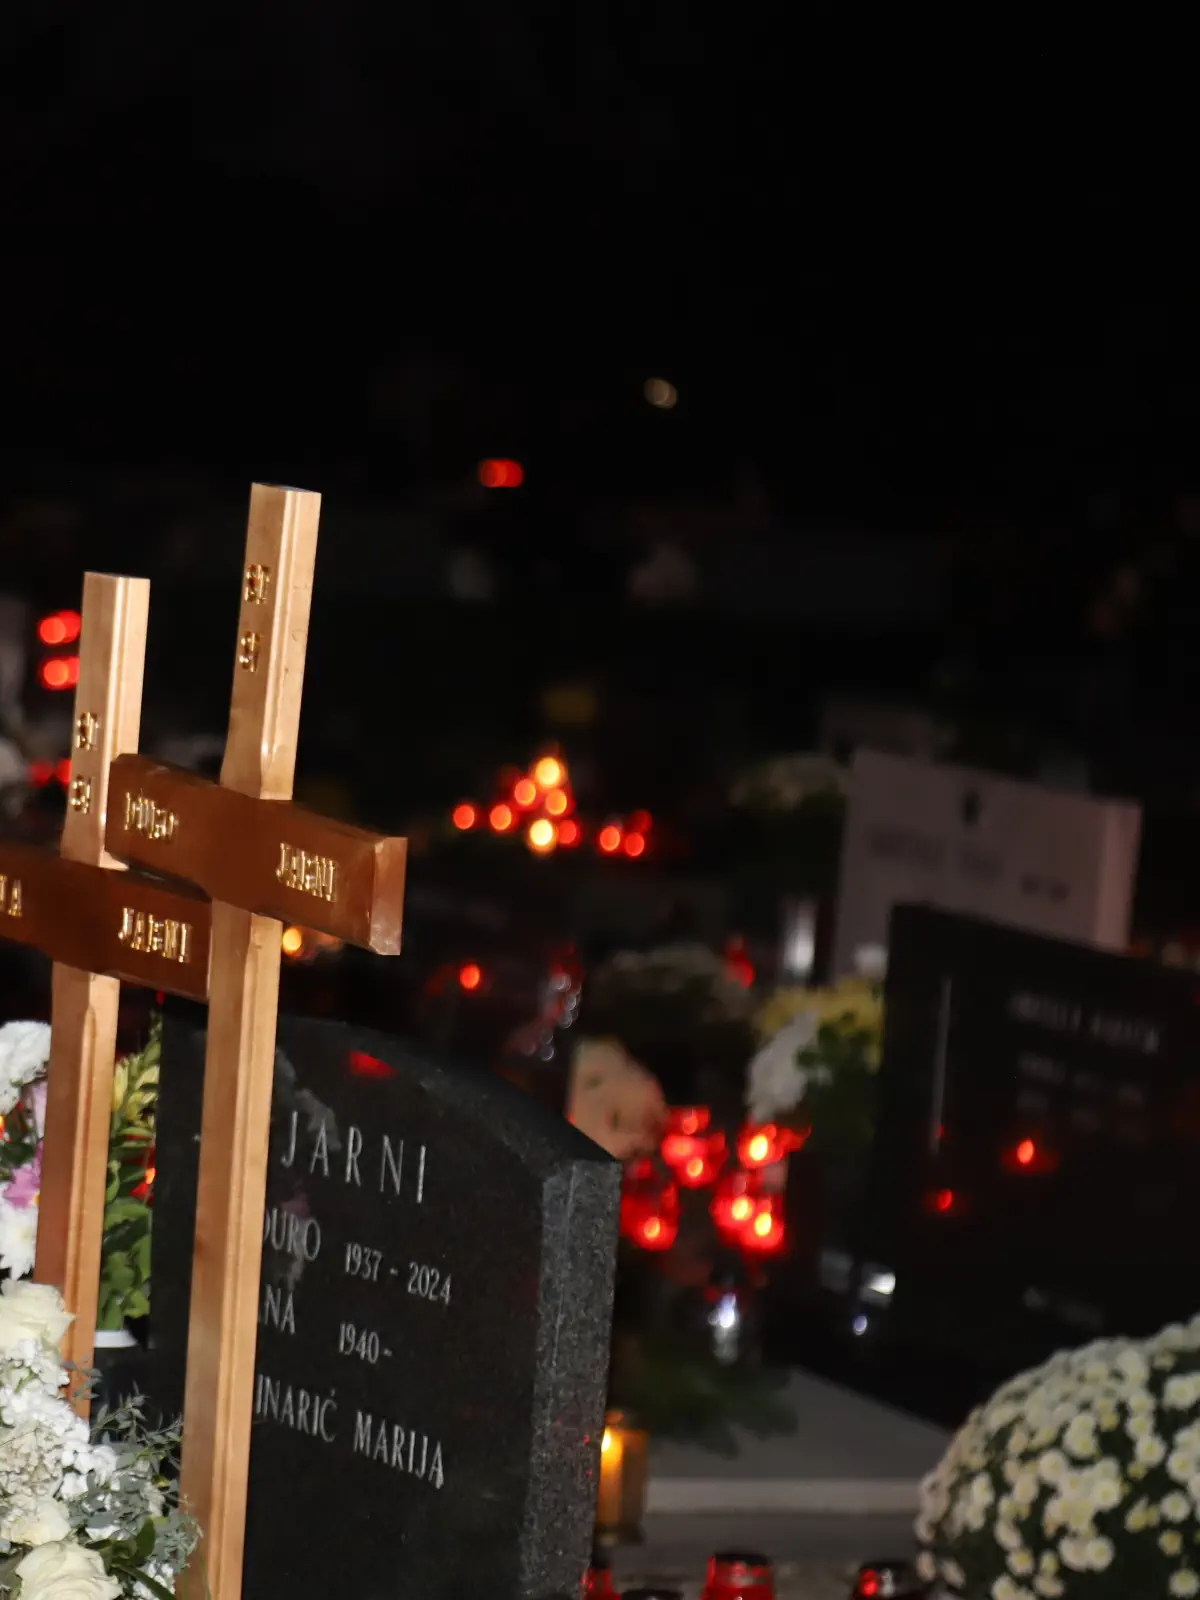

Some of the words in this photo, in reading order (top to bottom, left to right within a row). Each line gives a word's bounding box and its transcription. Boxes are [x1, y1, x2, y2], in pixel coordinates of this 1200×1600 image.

[280, 1110, 427, 1205] JARNI
[259, 1283, 296, 1336] NA
[344, 1242, 383, 1283] 1937
[407, 1261, 452, 1306] 2024
[253, 1372, 338, 1443] INARIĆ
[353, 1409, 445, 1491] MARIJA
